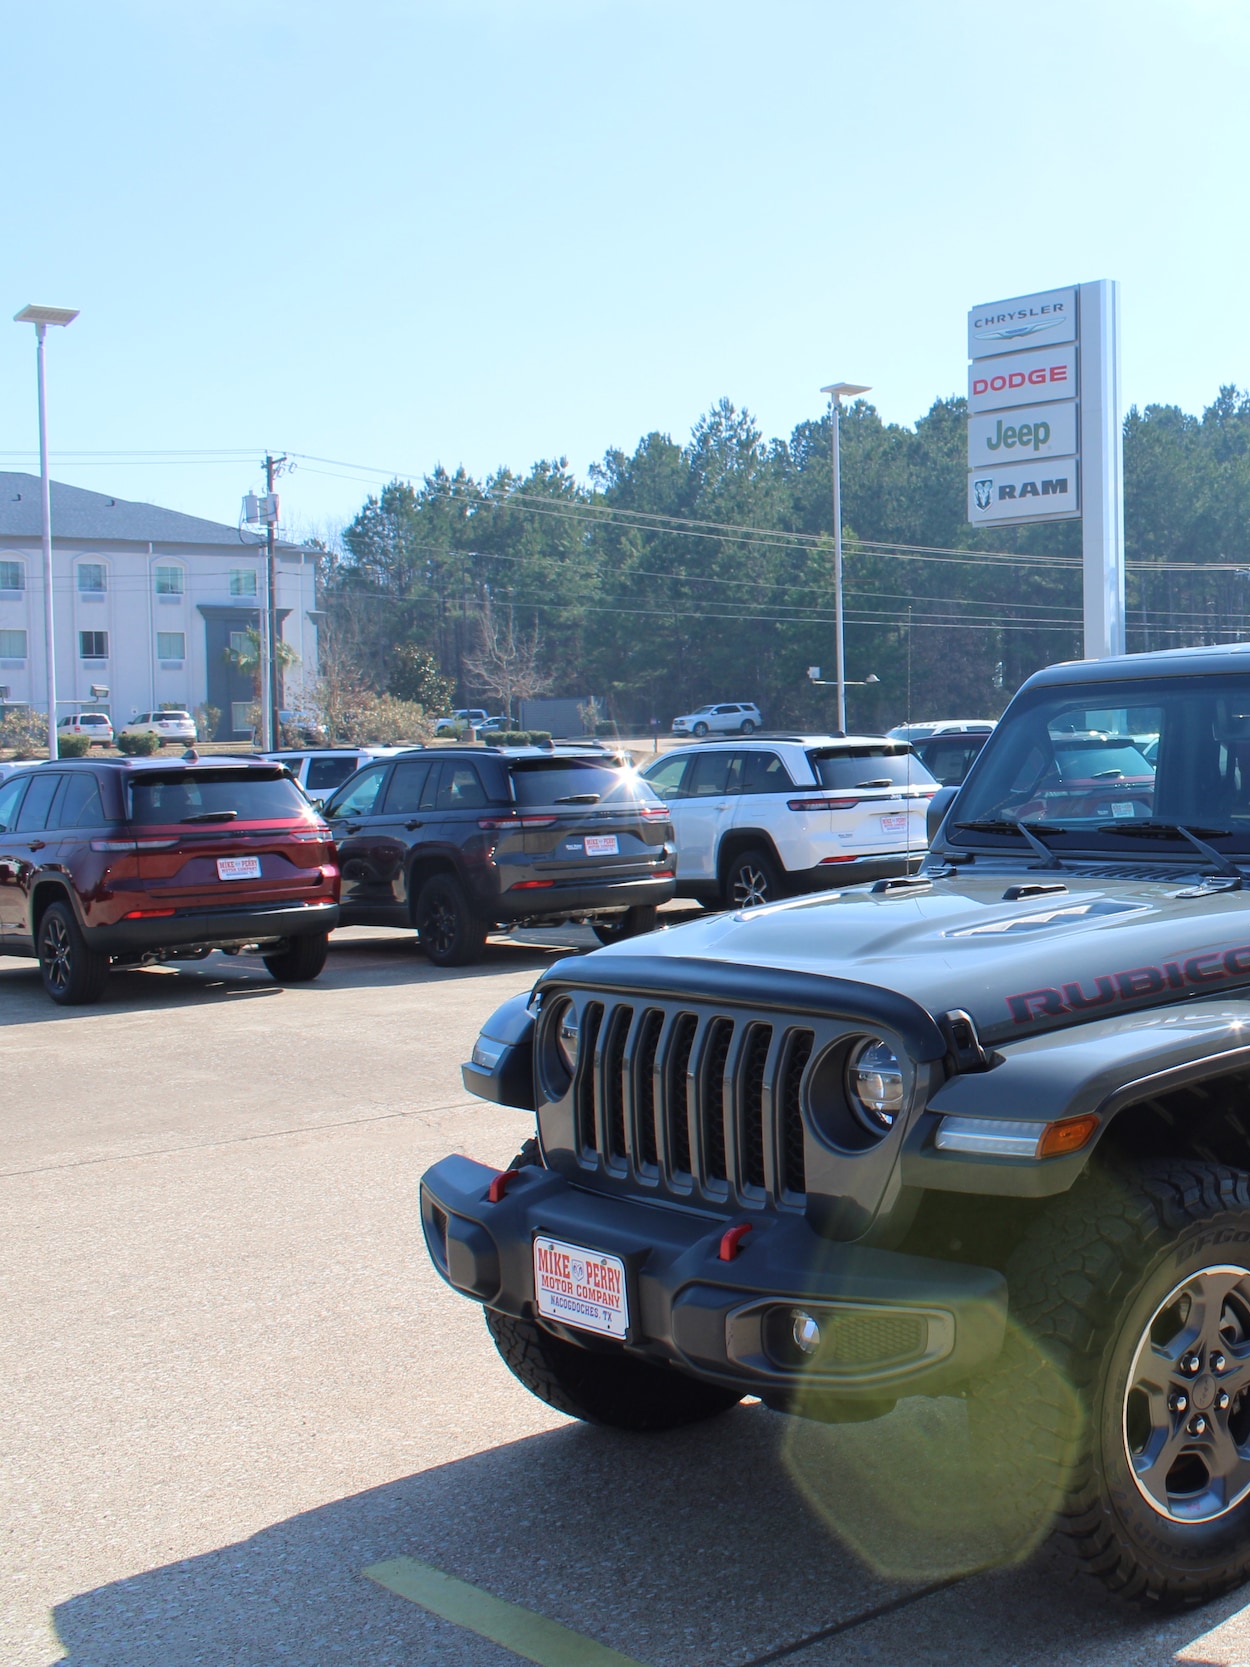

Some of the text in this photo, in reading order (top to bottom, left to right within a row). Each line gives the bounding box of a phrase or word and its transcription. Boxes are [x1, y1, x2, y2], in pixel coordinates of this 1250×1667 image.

[974, 303, 1064, 329] CHRYSLER
[973, 365, 1067, 395] DODGE
[986, 419, 1051, 452] Jeep
[998, 478, 1068, 501] RAM
[538, 1247, 621, 1294] MIKE PERRY
[541, 1274, 621, 1309] MOTOR COMPANY
[602, 1310, 613, 1322] TX
